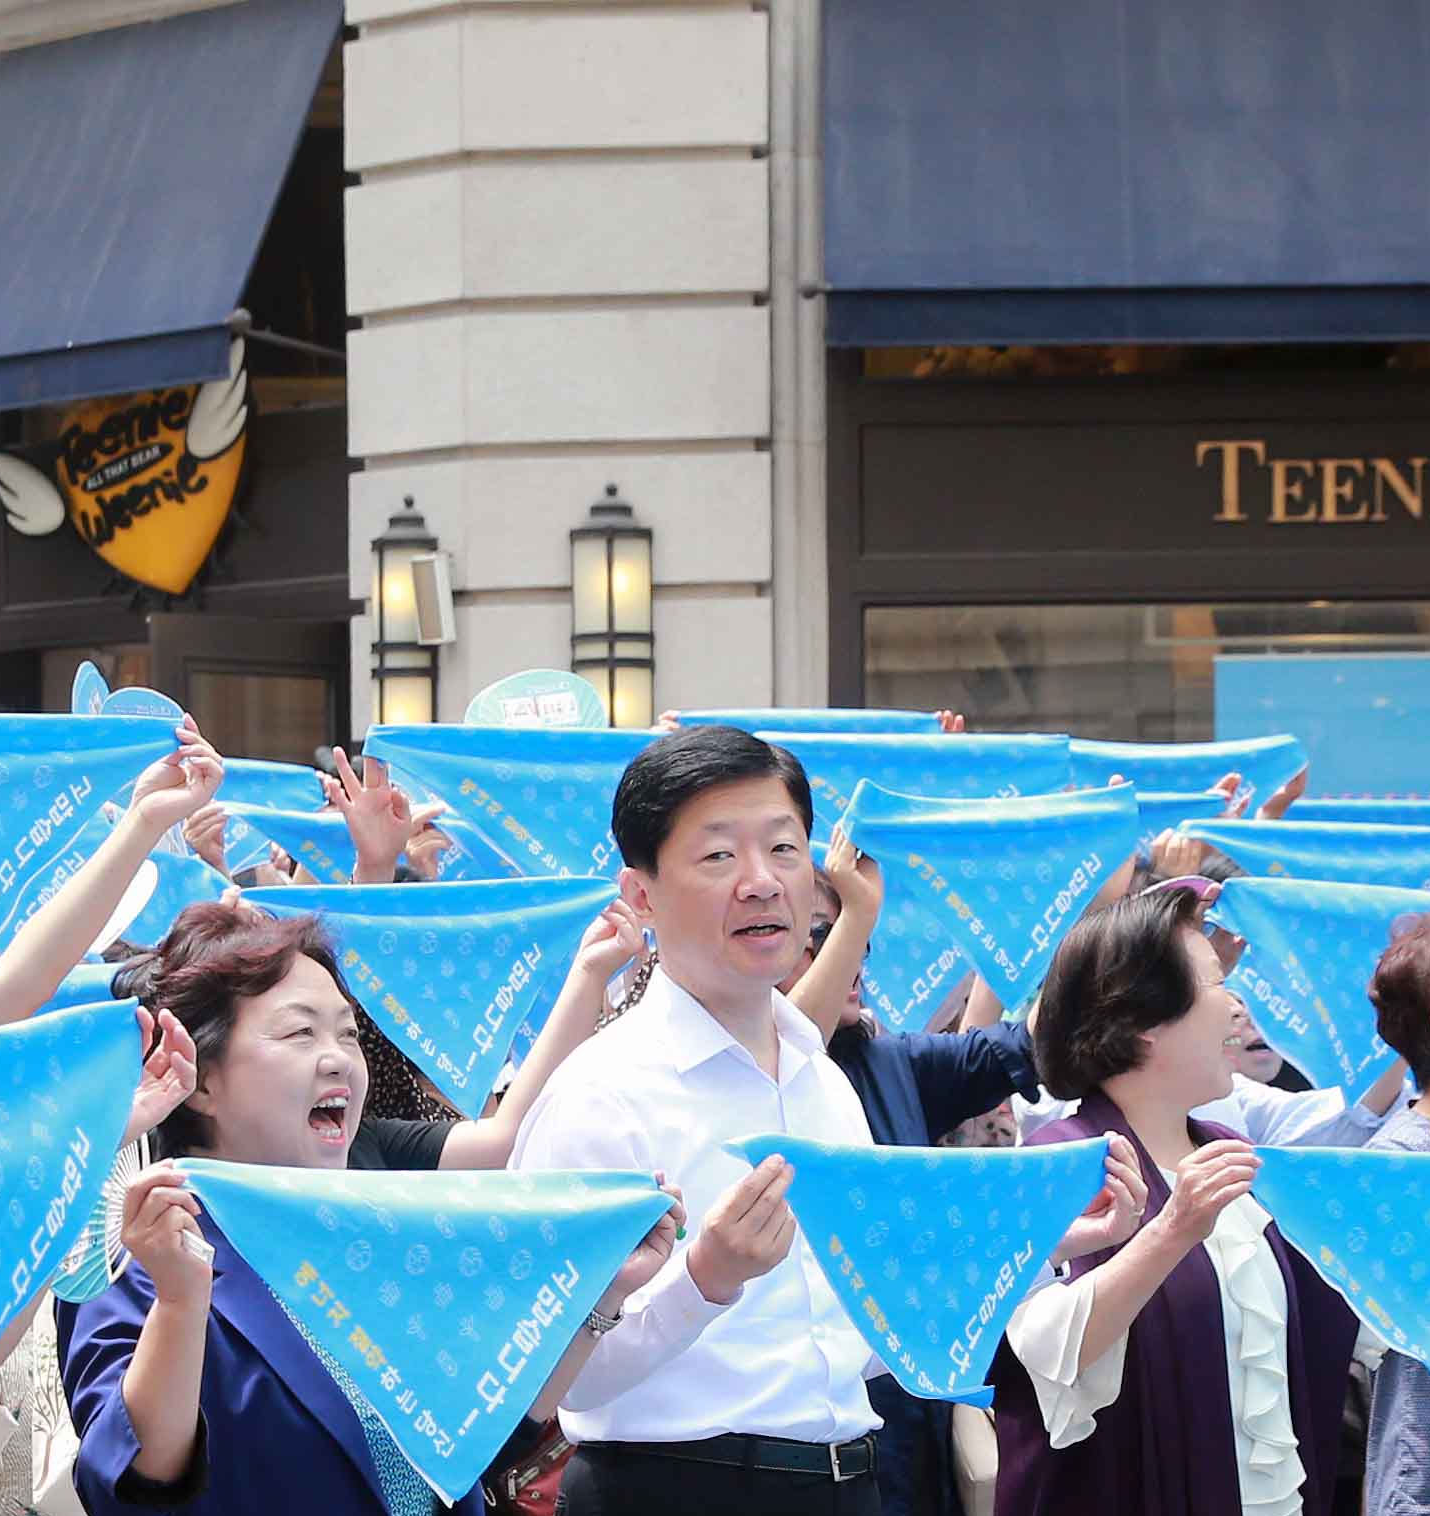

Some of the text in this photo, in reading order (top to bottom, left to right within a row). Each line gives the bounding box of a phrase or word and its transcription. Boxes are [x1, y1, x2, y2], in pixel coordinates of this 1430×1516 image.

[1021, 852, 1103, 968] 고맙습니다!
[465, 942, 543, 1072] 고맙습니다!
[294, 1260, 351, 1329] 에너지
[412, 1409, 457, 1459] 당신
[458, 1258, 580, 1437] 고맙습니다!
[948, 1239, 1034, 1393] 고맙습니다!
